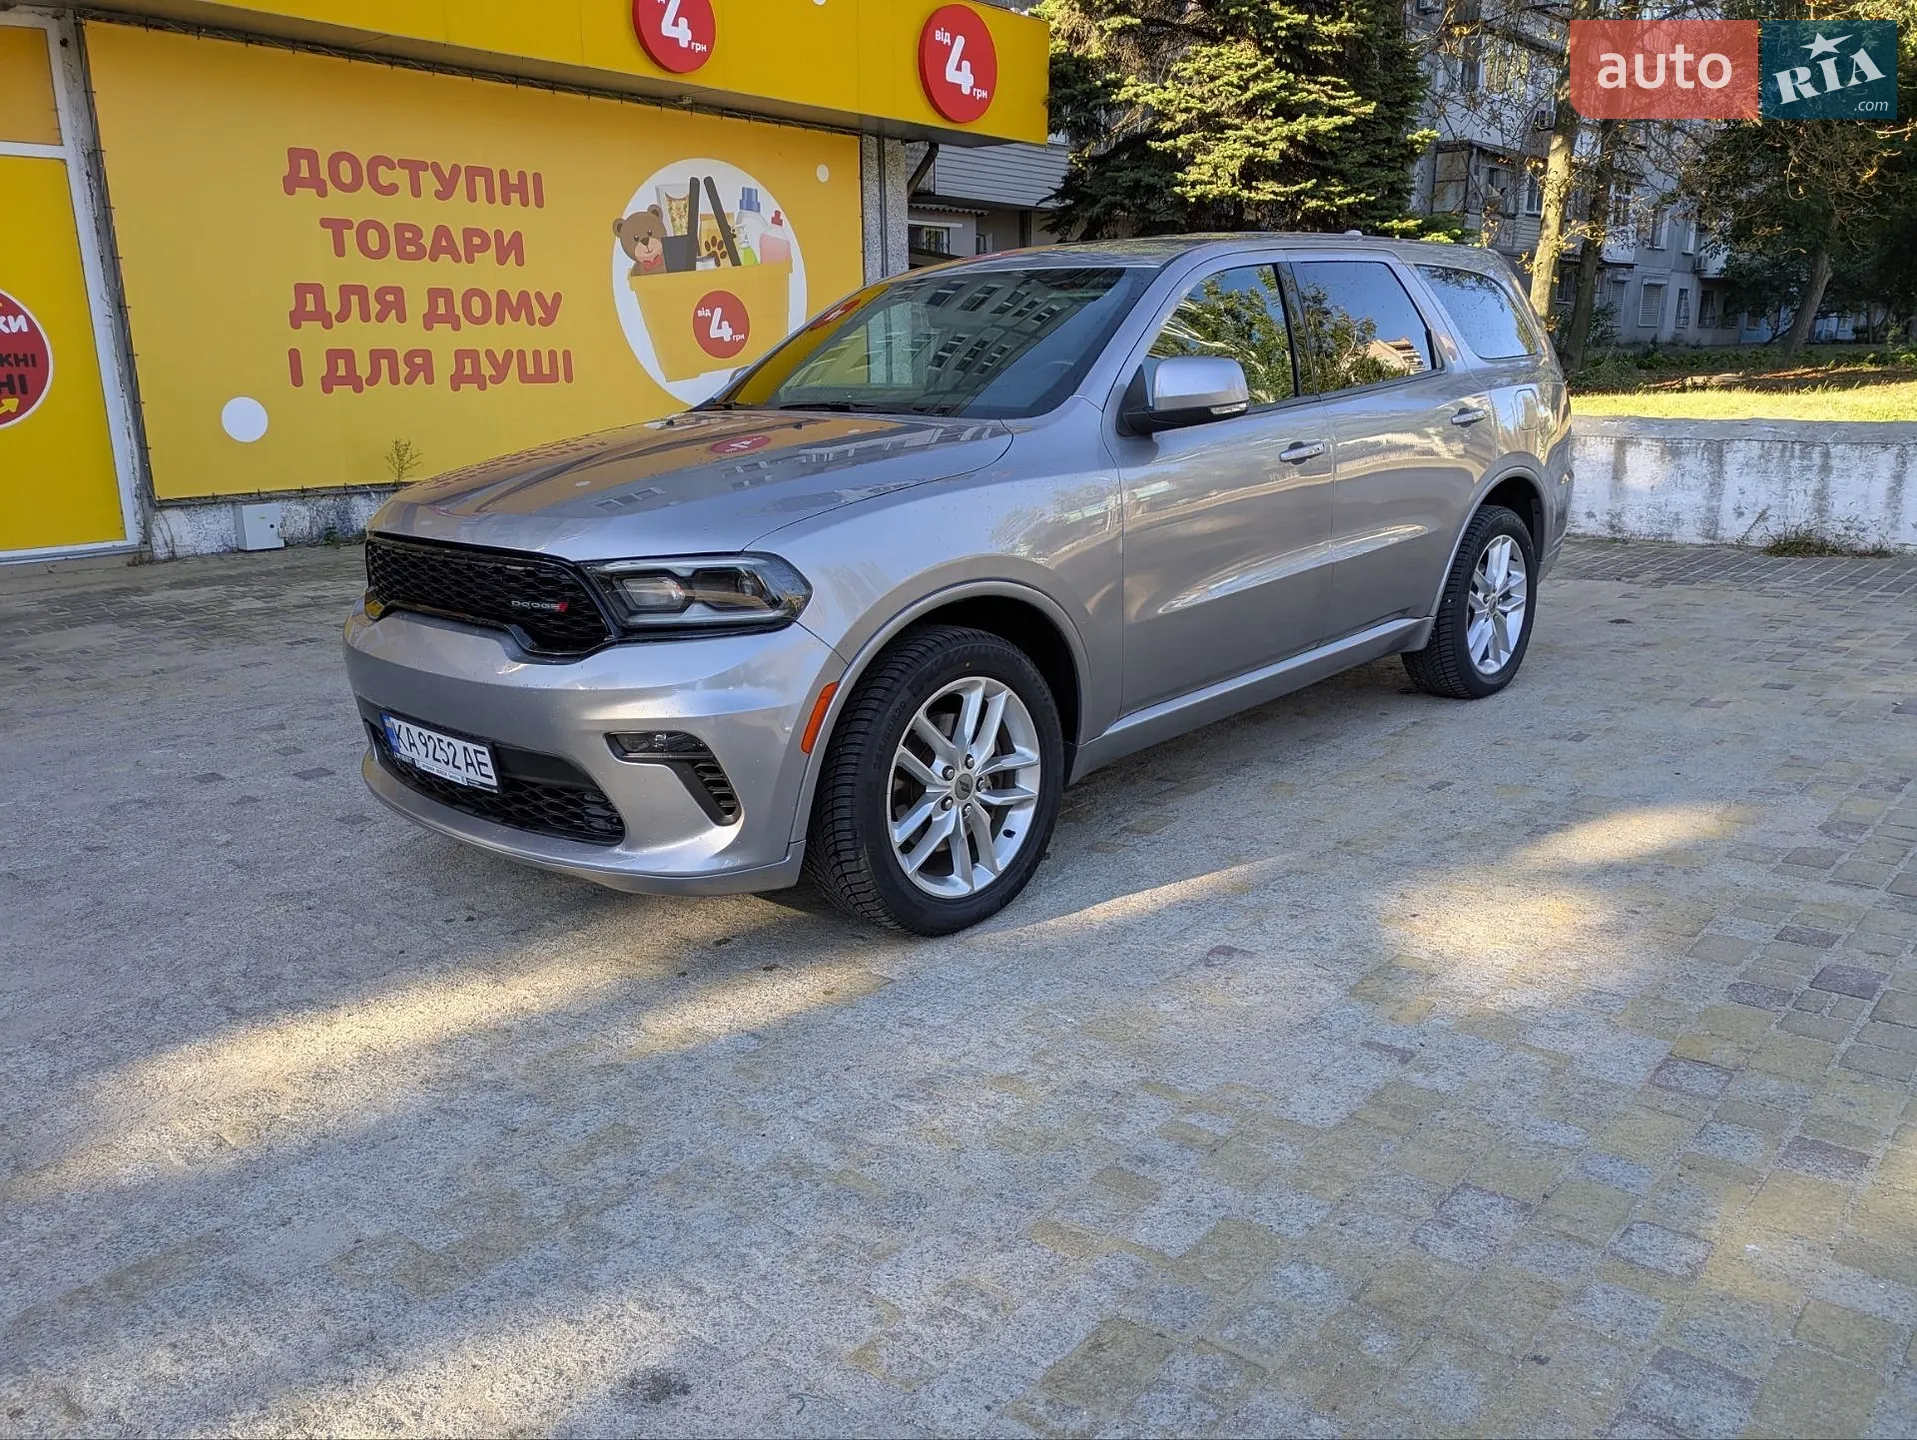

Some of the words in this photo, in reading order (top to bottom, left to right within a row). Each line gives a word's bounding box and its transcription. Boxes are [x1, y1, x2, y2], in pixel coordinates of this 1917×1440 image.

[661, 0, 692, 48] 4
[691, 42, 707, 53] грн
[935, 27, 951, 46] від
[946, 35, 974, 95] 4
[973, 87, 988, 100] грн
[282, 147, 545, 209] ДОСТУПНІ
[319, 217, 525, 267] ТОВАРИ
[289, 282, 408, 330] ДЛЯ
[423, 287, 563, 331] ДОМУ
[697, 307, 711, 318] від
[710, 307, 733, 342] 4
[732, 333, 745, 342] грн
[288, 348, 304, 387] І
[321, 349, 435, 394] ДЛЯ
[450, 349, 574, 392] ДУШІ
[391, 722, 420, 755] KA
[417, 731, 462, 770] 9252
[462, 746, 493, 779] AE
